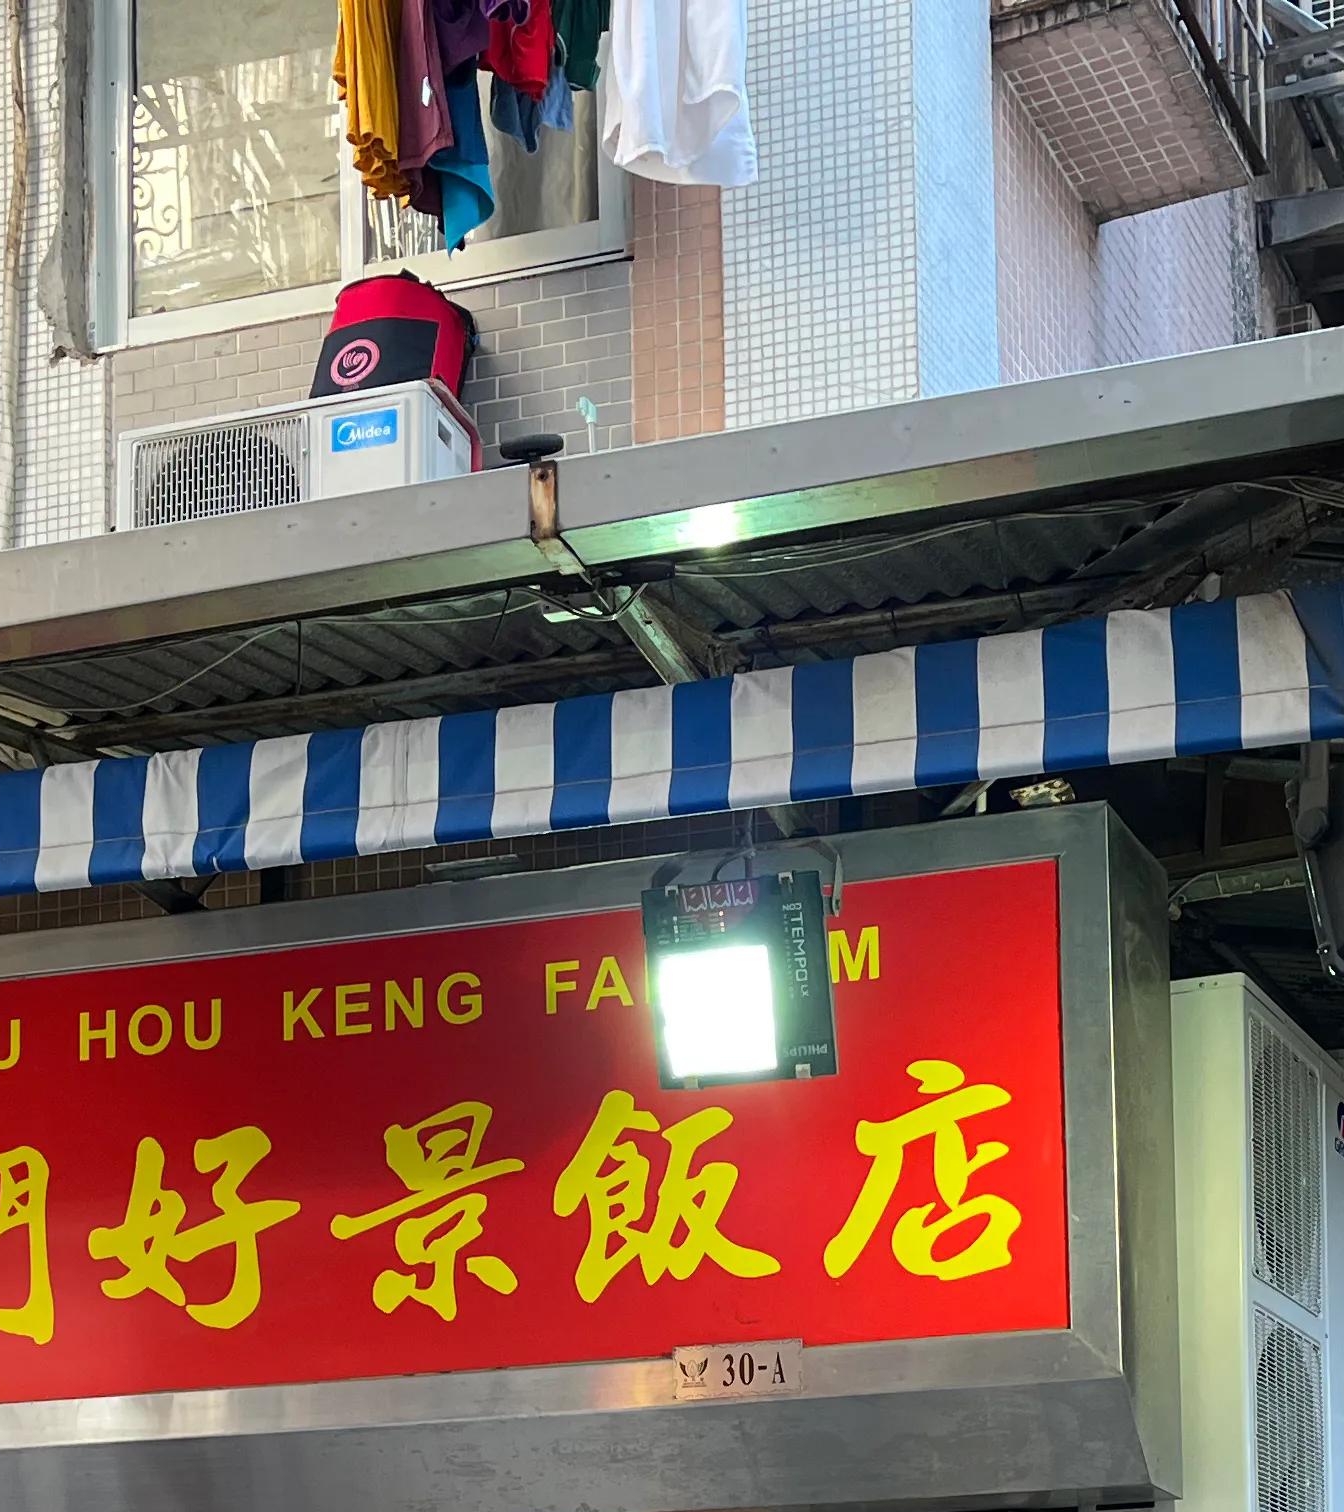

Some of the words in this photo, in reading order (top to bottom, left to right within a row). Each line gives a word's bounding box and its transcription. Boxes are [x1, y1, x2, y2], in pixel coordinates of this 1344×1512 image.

[337, 420, 392, 446] Midea
[790, 911, 808, 982] TEMPO
[78, 1002, 223, 1062] HOU
[283, 969, 485, 1043] KENG
[783, 1043, 828, 1058] PHILIPS
[722, 1351, 787, 1387] 30-A
